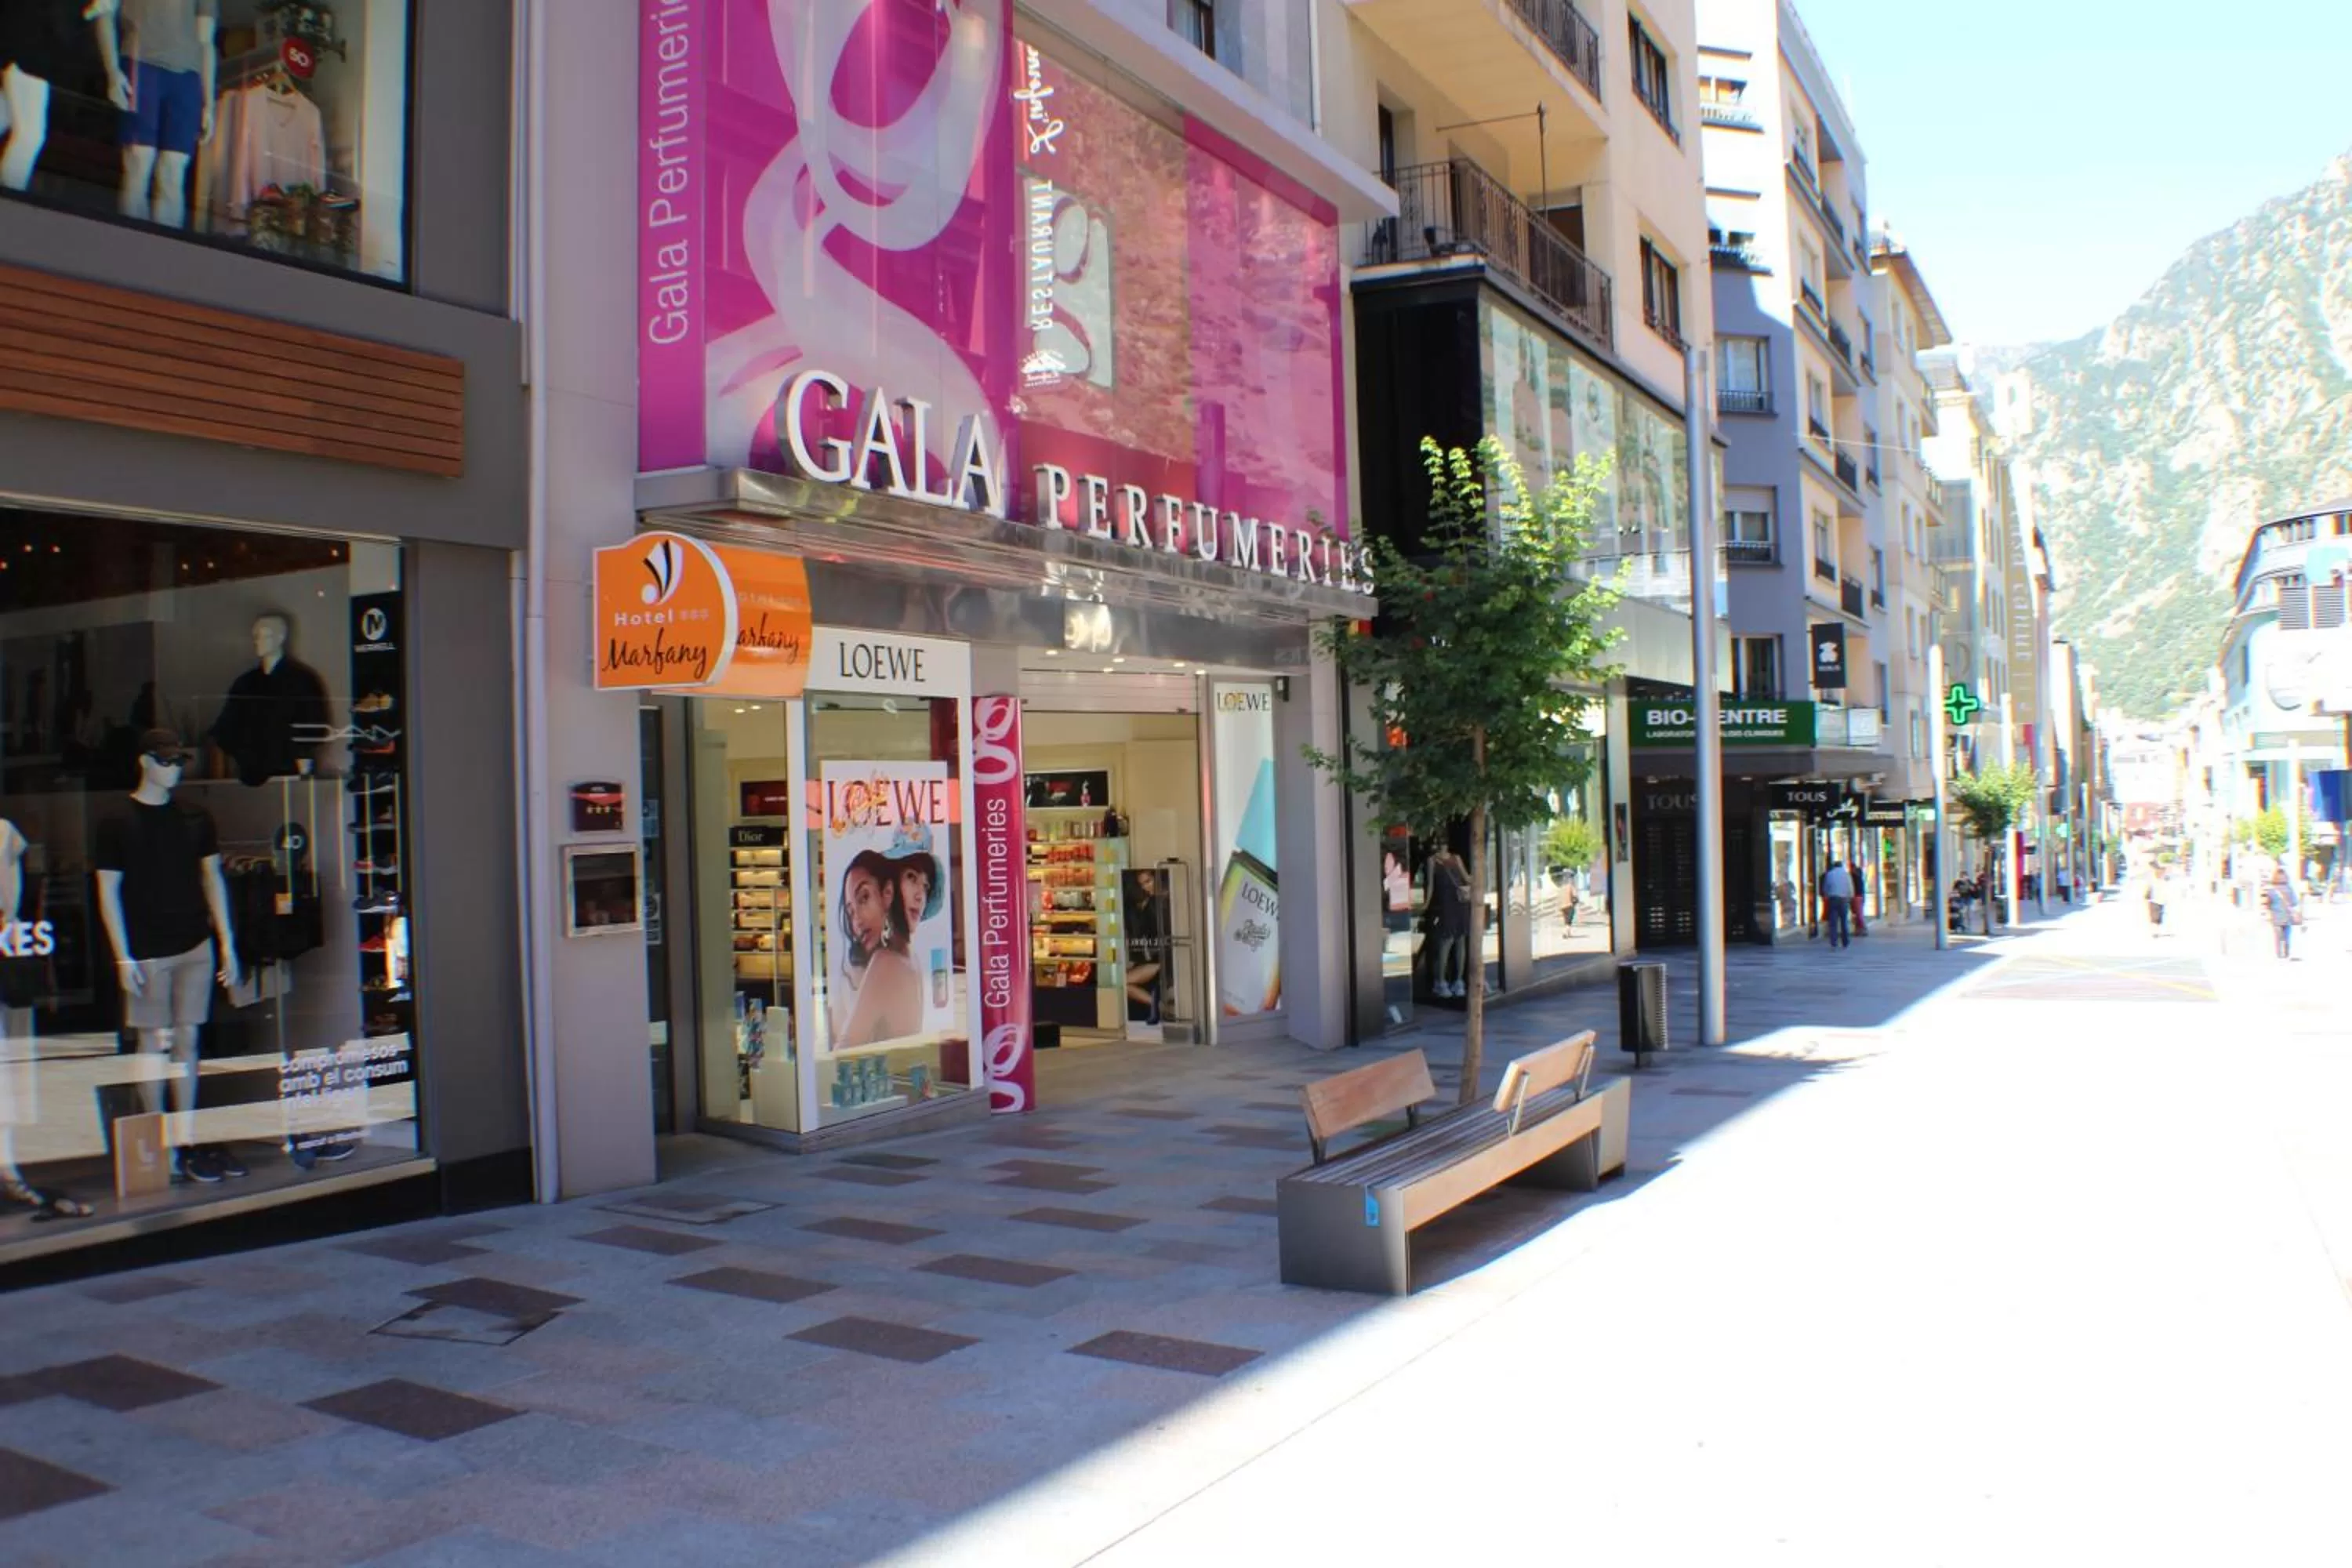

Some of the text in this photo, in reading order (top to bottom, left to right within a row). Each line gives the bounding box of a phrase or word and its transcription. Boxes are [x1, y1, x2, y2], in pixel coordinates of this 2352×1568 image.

[649, 239, 689, 344] Gala
[780, 369, 1377, 595] GALA PERFUMERIES
[614, 608, 674, 626] Hotel
[601, 626, 707, 680] Marfany
[736, 612, 800, 665] arfany
[840, 641, 926, 683] LOEWE
[1216, 691, 1271, 712] LOEWE
[1646, 709, 1788, 725] BIO-ENTRE
[826, 779, 946, 829] LOEWE
[1788, 791, 1828, 802] TOUS
[738, 829, 763, 843] Dior
[982, 798, 1011, 1009] Gala Perfumeries
[1241, 881, 1280, 922] LOEW
[279, 1058, 410, 1093] amb el consum
